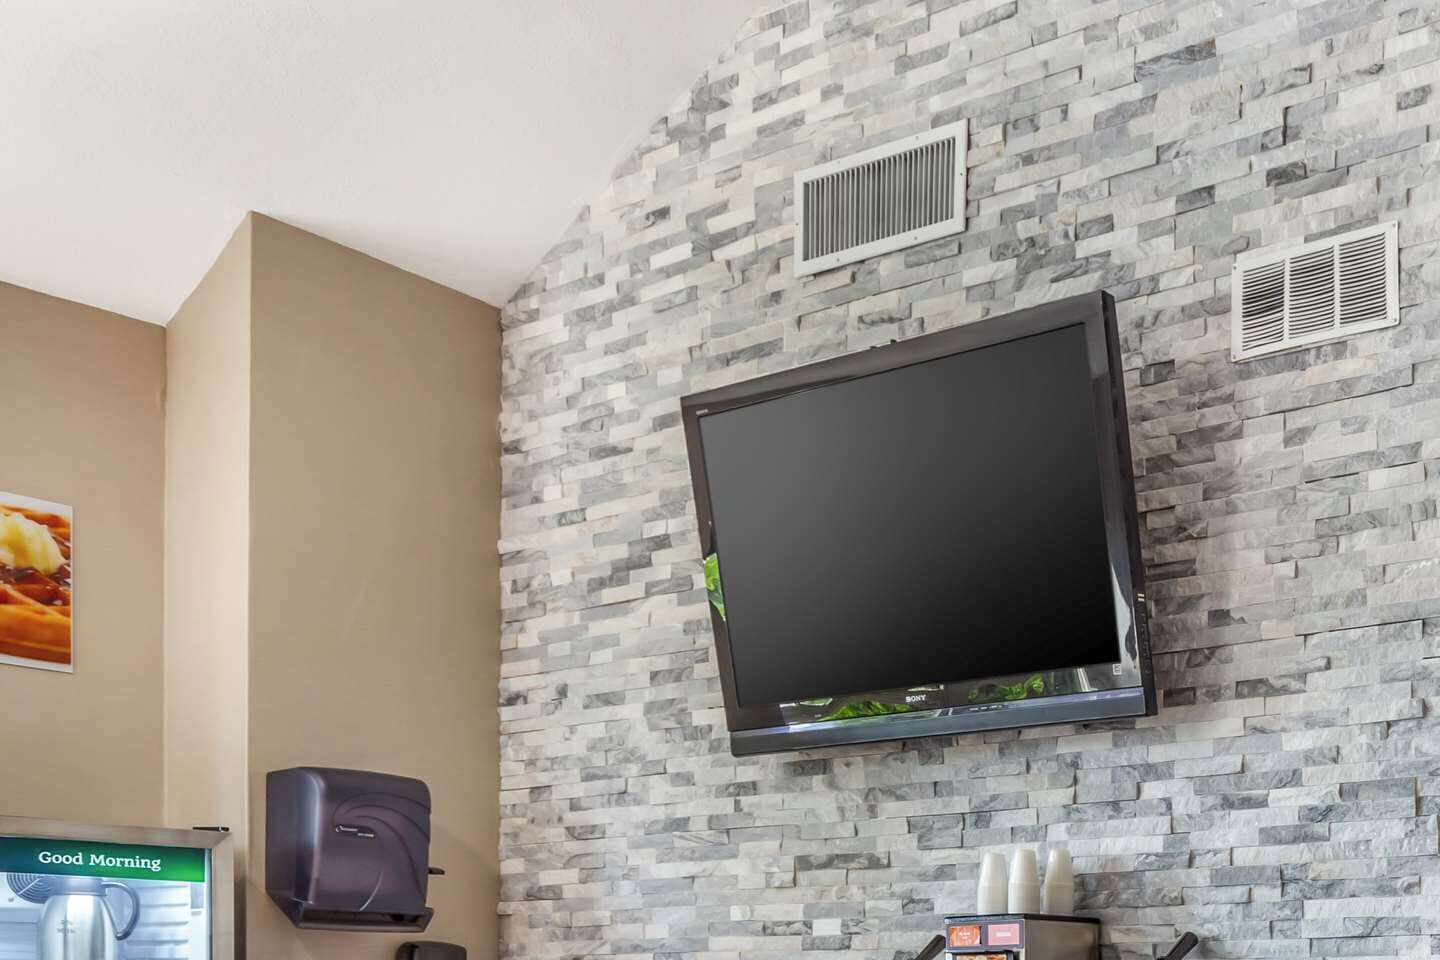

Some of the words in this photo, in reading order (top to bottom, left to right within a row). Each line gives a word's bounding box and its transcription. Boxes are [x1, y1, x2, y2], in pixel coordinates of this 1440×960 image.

[905, 694, 927, 703] SONY
[38, 851, 84, 865] Good
[89, 853, 162, 872] Morning
